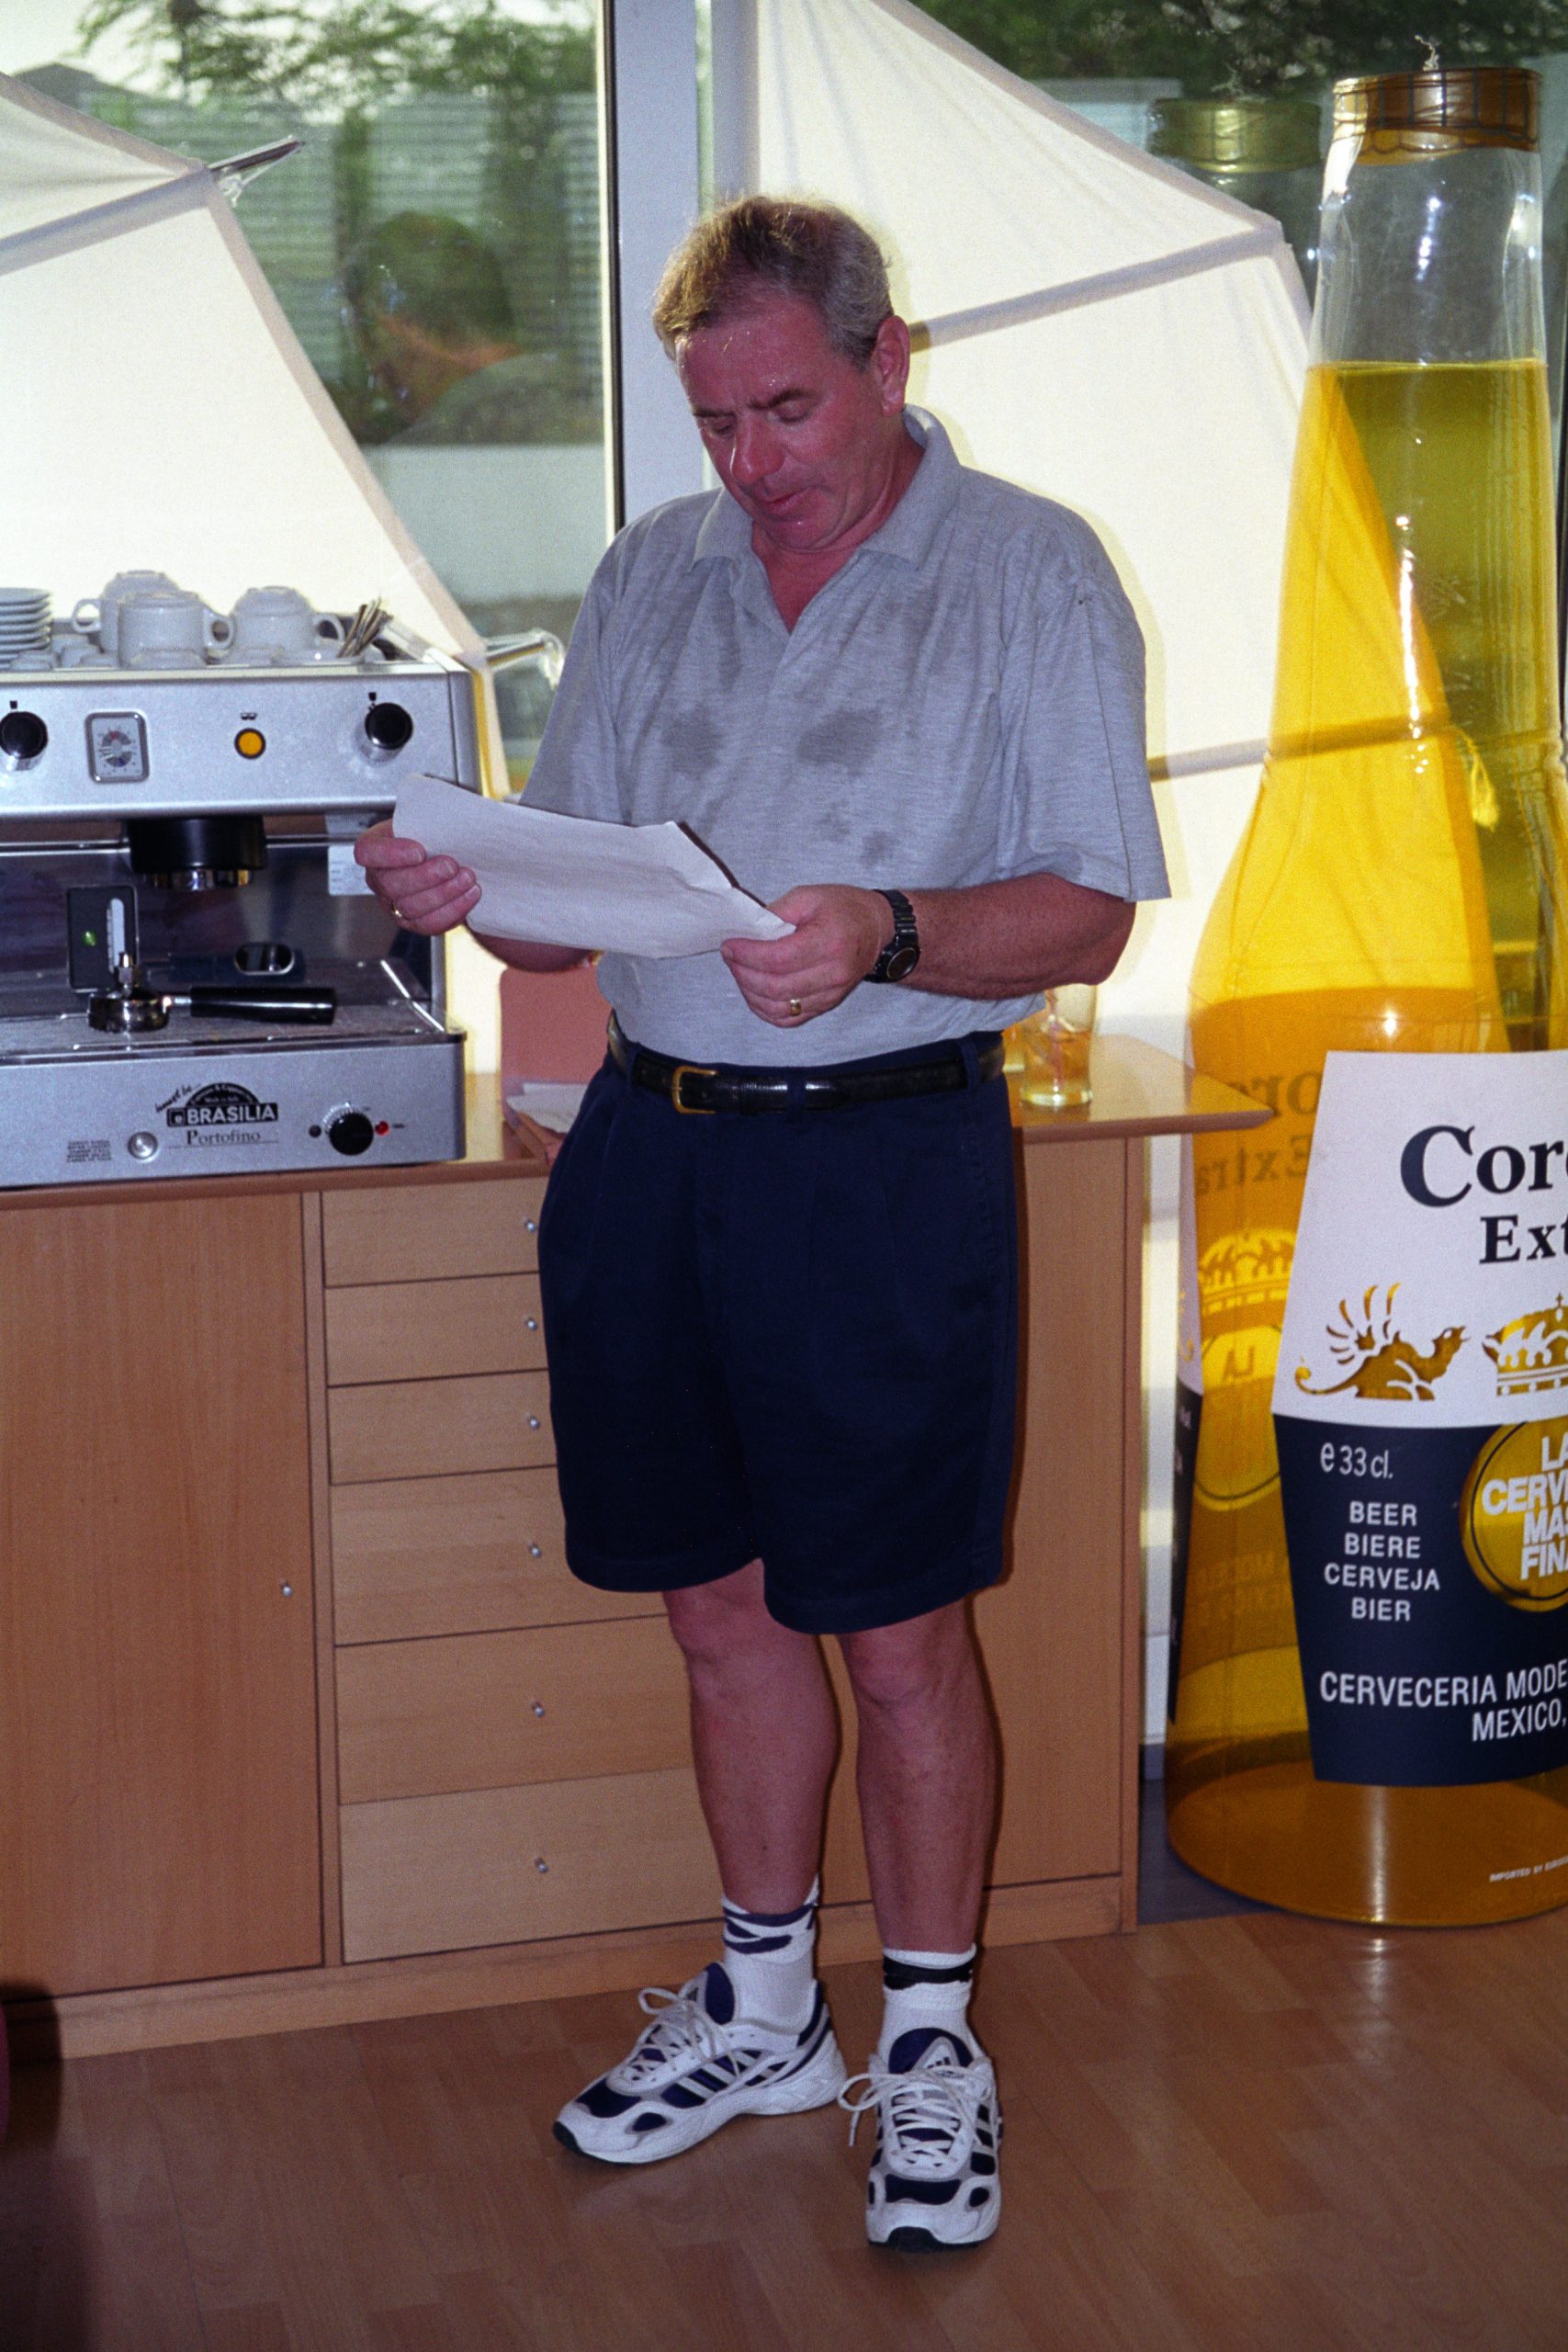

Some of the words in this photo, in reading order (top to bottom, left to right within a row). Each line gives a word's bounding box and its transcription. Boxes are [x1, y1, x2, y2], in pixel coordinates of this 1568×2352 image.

[186, 1104, 276, 1125] BRASILIA
[186, 1129, 261, 1146] Portofino
[1400, 1125, 1568, 1208] Cor
[1482, 1467, 1568, 1516] CERV
[1348, 1500, 1417, 1527] BEER
[1523, 1503, 1568, 1546] MA
[1344, 1532, 1421, 1559] BIERE
[1324, 1563, 1441, 1591] CERVEJA
[1351, 1597, 1411, 1622] BIER
[1319, 1670, 1497, 1708] CERVECERIA
[1472, 1698, 1567, 1742] MEXICO,
